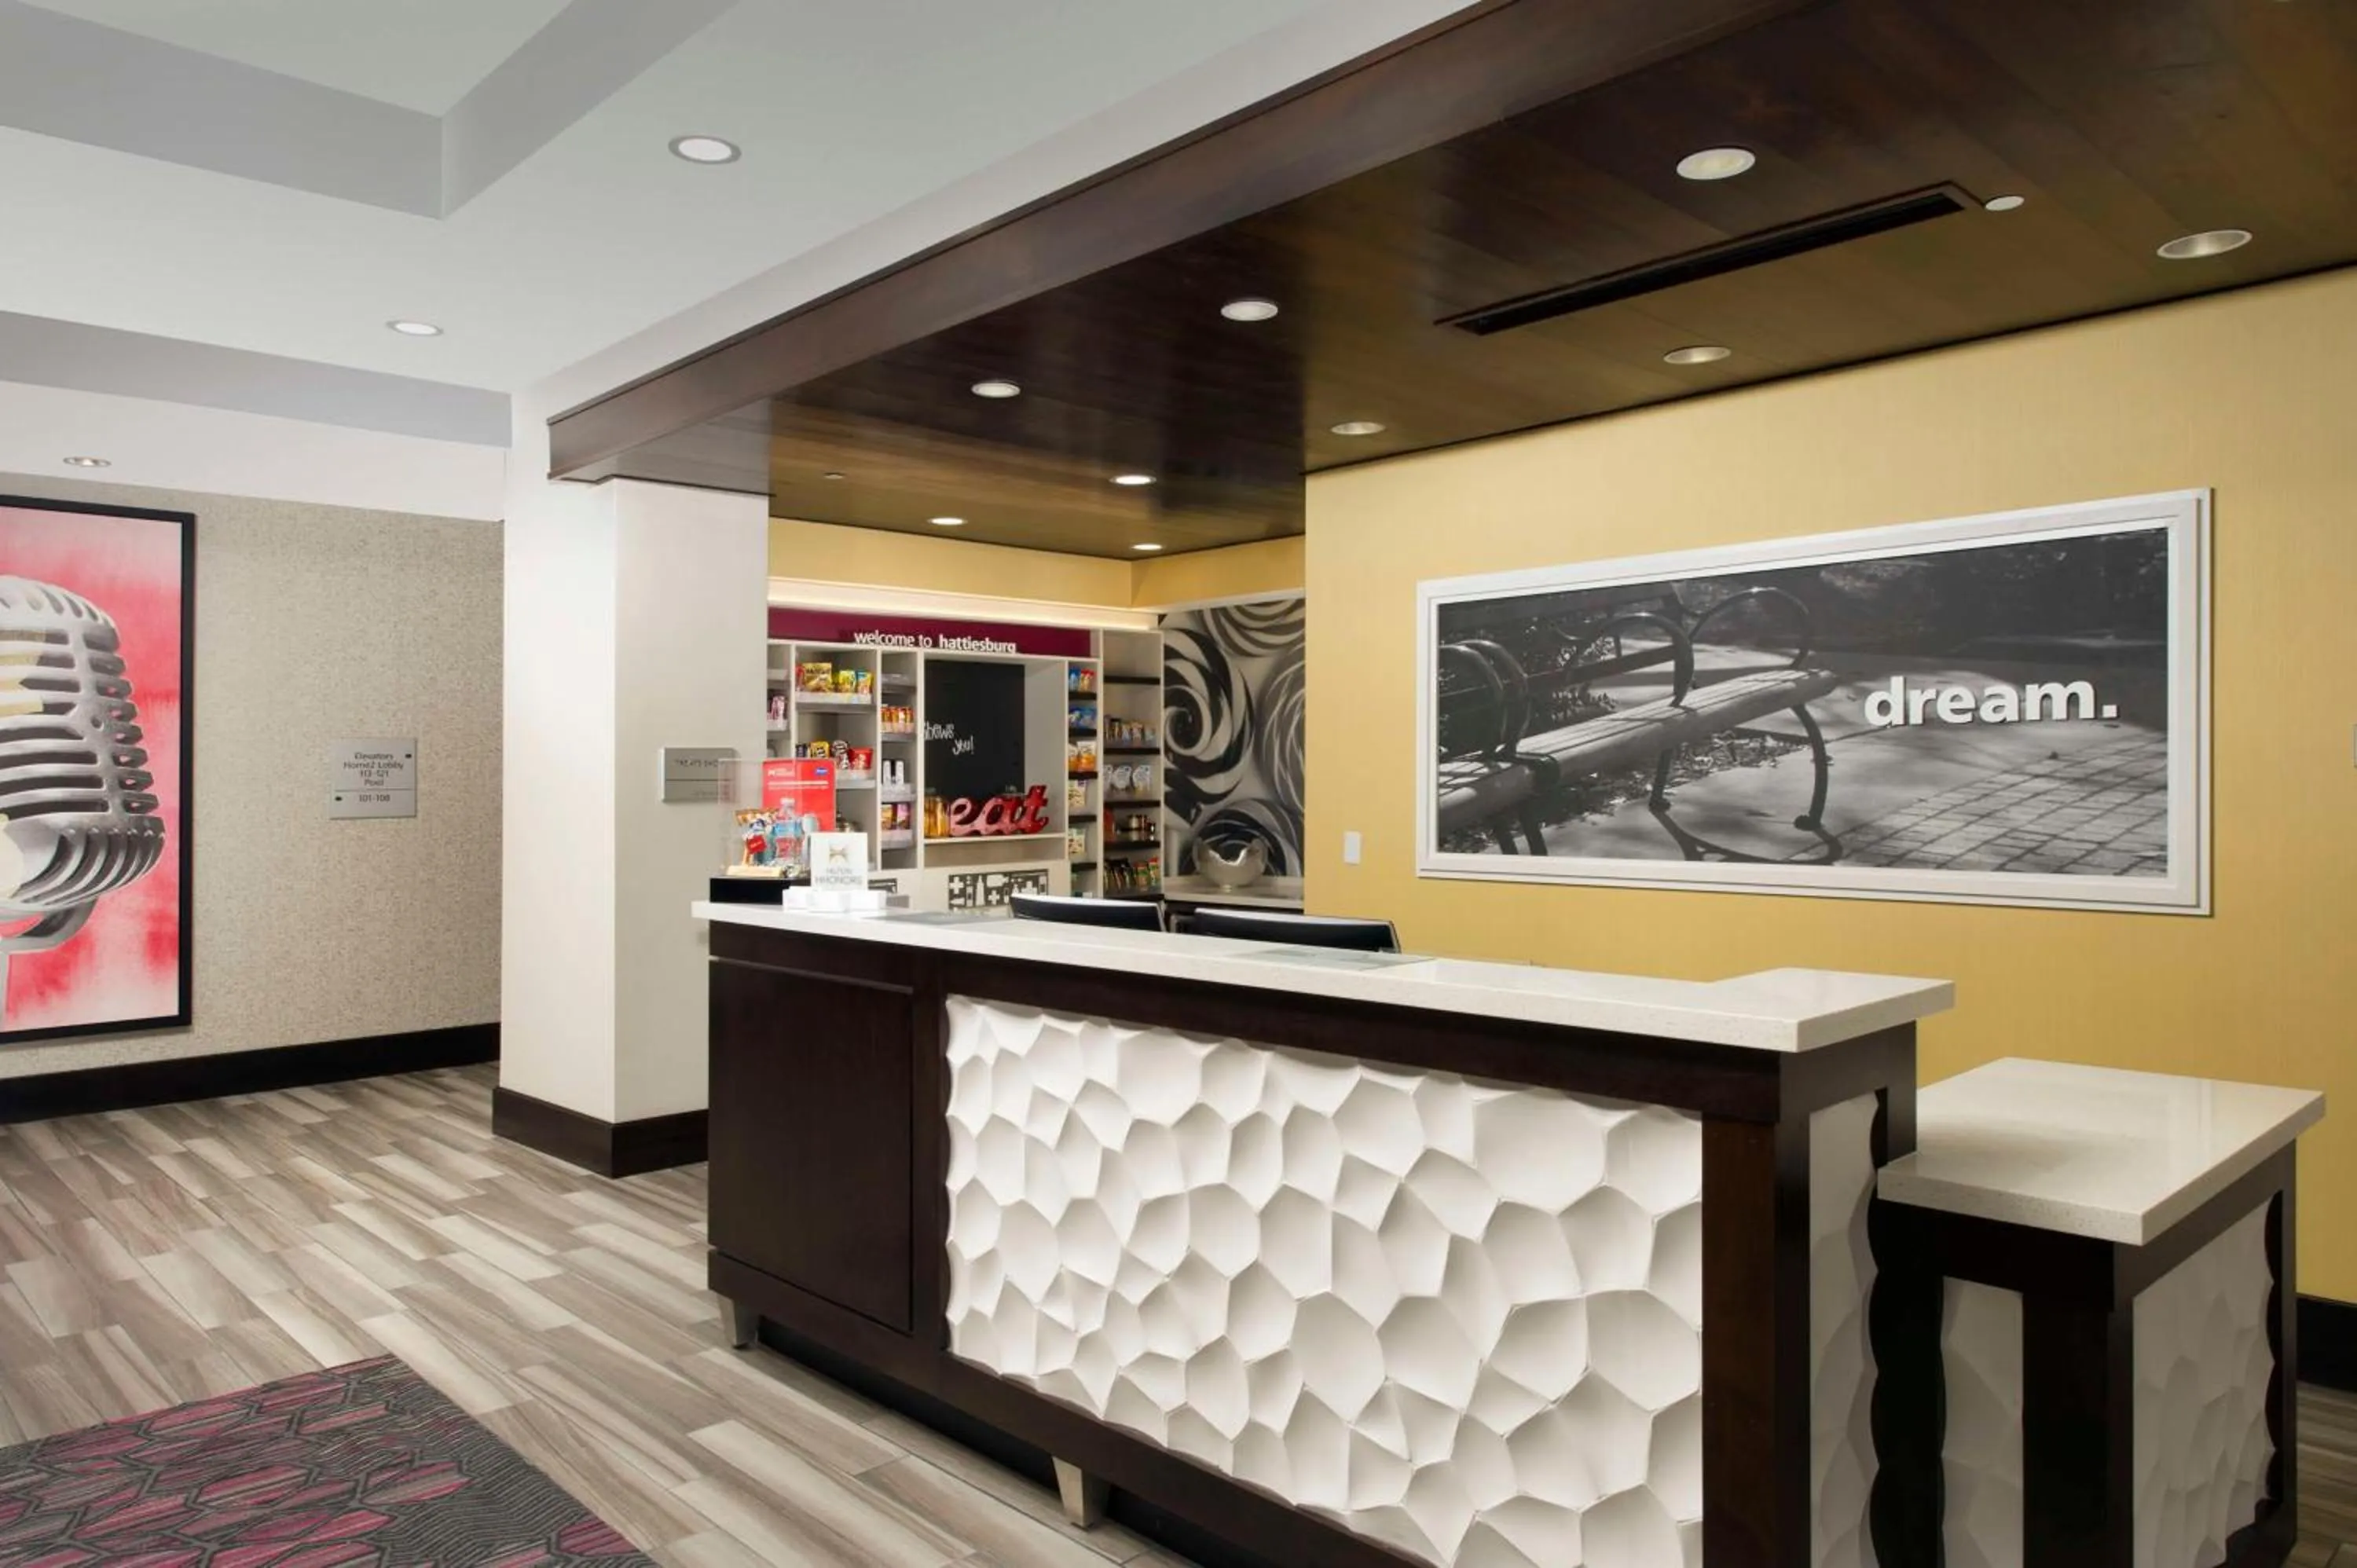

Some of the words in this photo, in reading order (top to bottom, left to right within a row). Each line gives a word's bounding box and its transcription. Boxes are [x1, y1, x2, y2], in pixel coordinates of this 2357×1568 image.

[854, 629, 915, 647] welcome
[918, 634, 933, 648] to
[939, 634, 1016, 654] hattiesburg
[1864, 676, 2117, 728] dream.
[378, 761, 404, 770] Lobby
[949, 784, 1050, 837] eat
